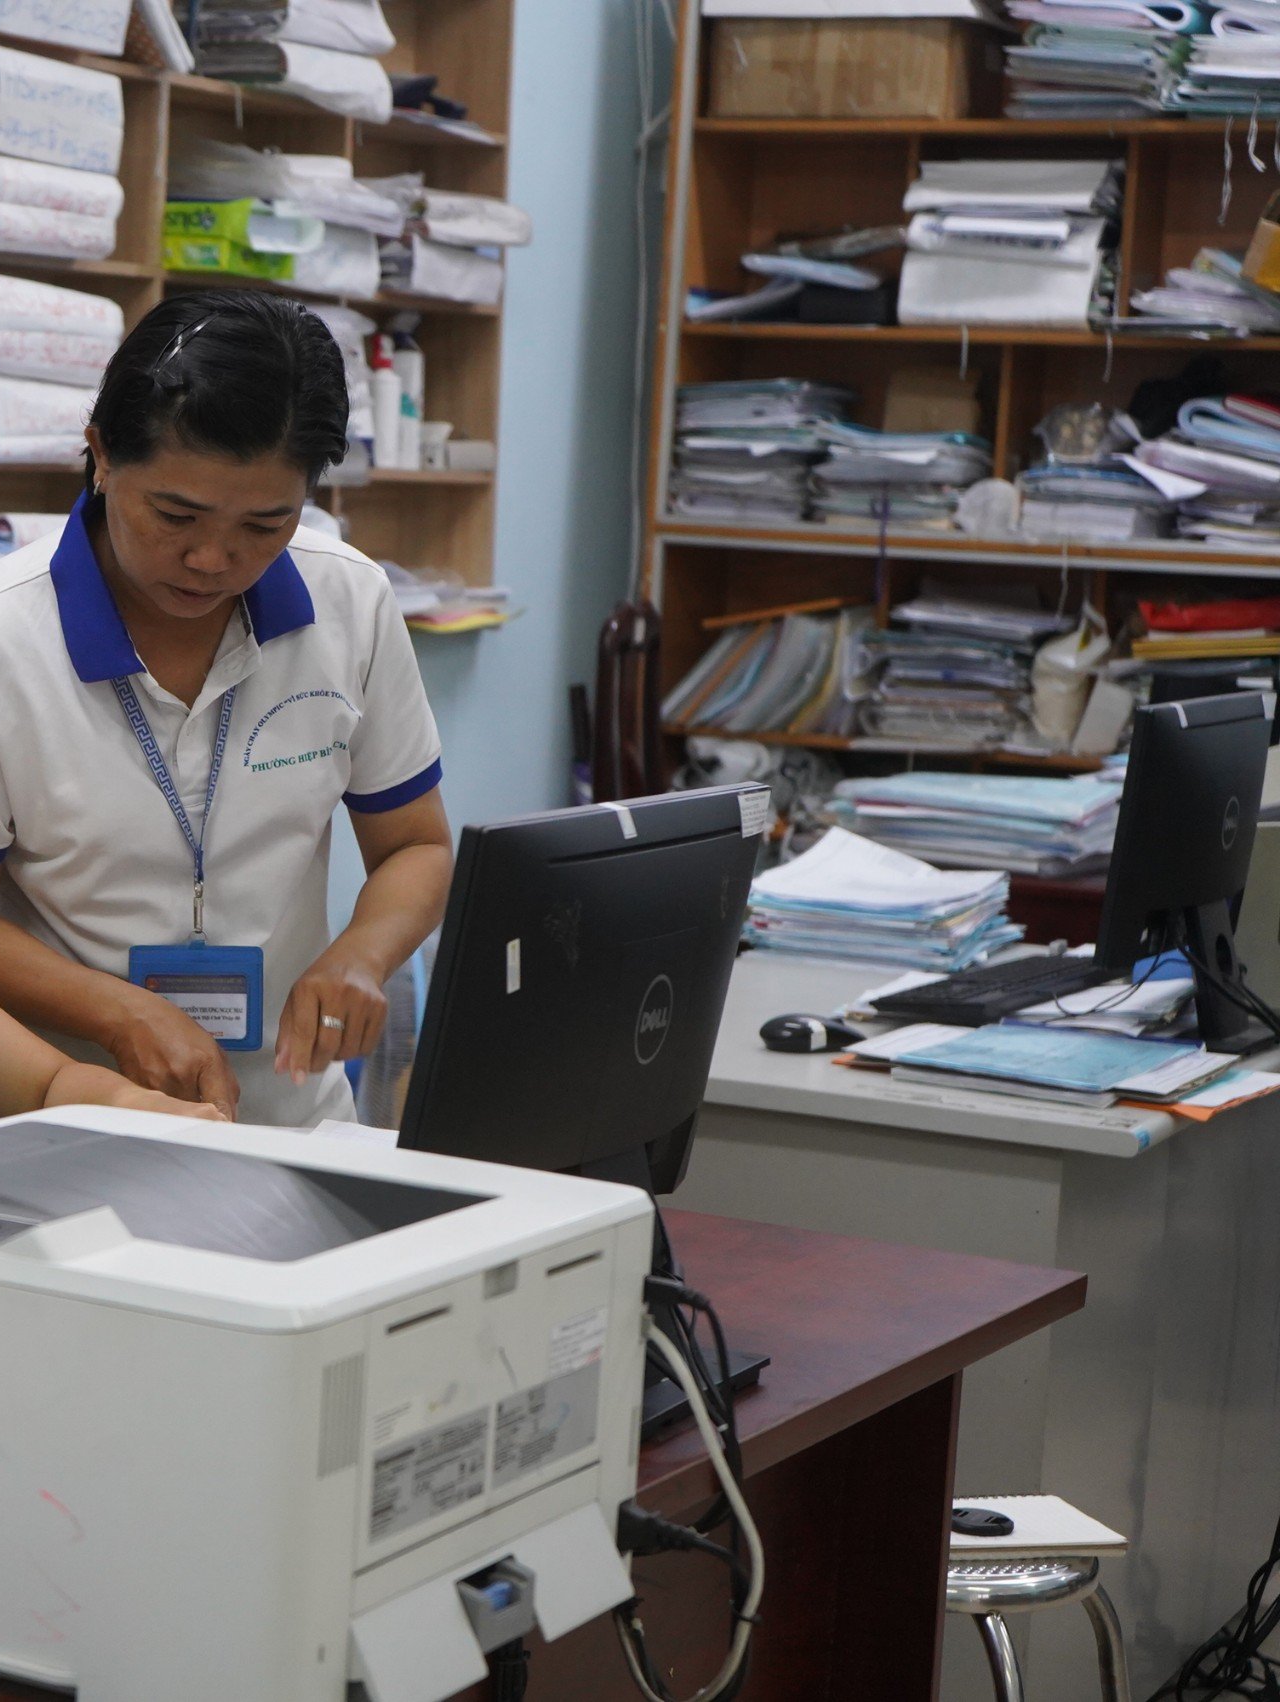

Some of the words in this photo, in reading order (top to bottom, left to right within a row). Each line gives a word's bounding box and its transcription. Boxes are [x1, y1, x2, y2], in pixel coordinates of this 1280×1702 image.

[247, 726, 260, 746] CHẠY
[258, 702, 284, 727] OLYMPIC
[252, 756, 296, 772] PHƯỜNG
[298, 750, 318, 763] HIỆP
[640, 1006, 668, 1033] DELL
